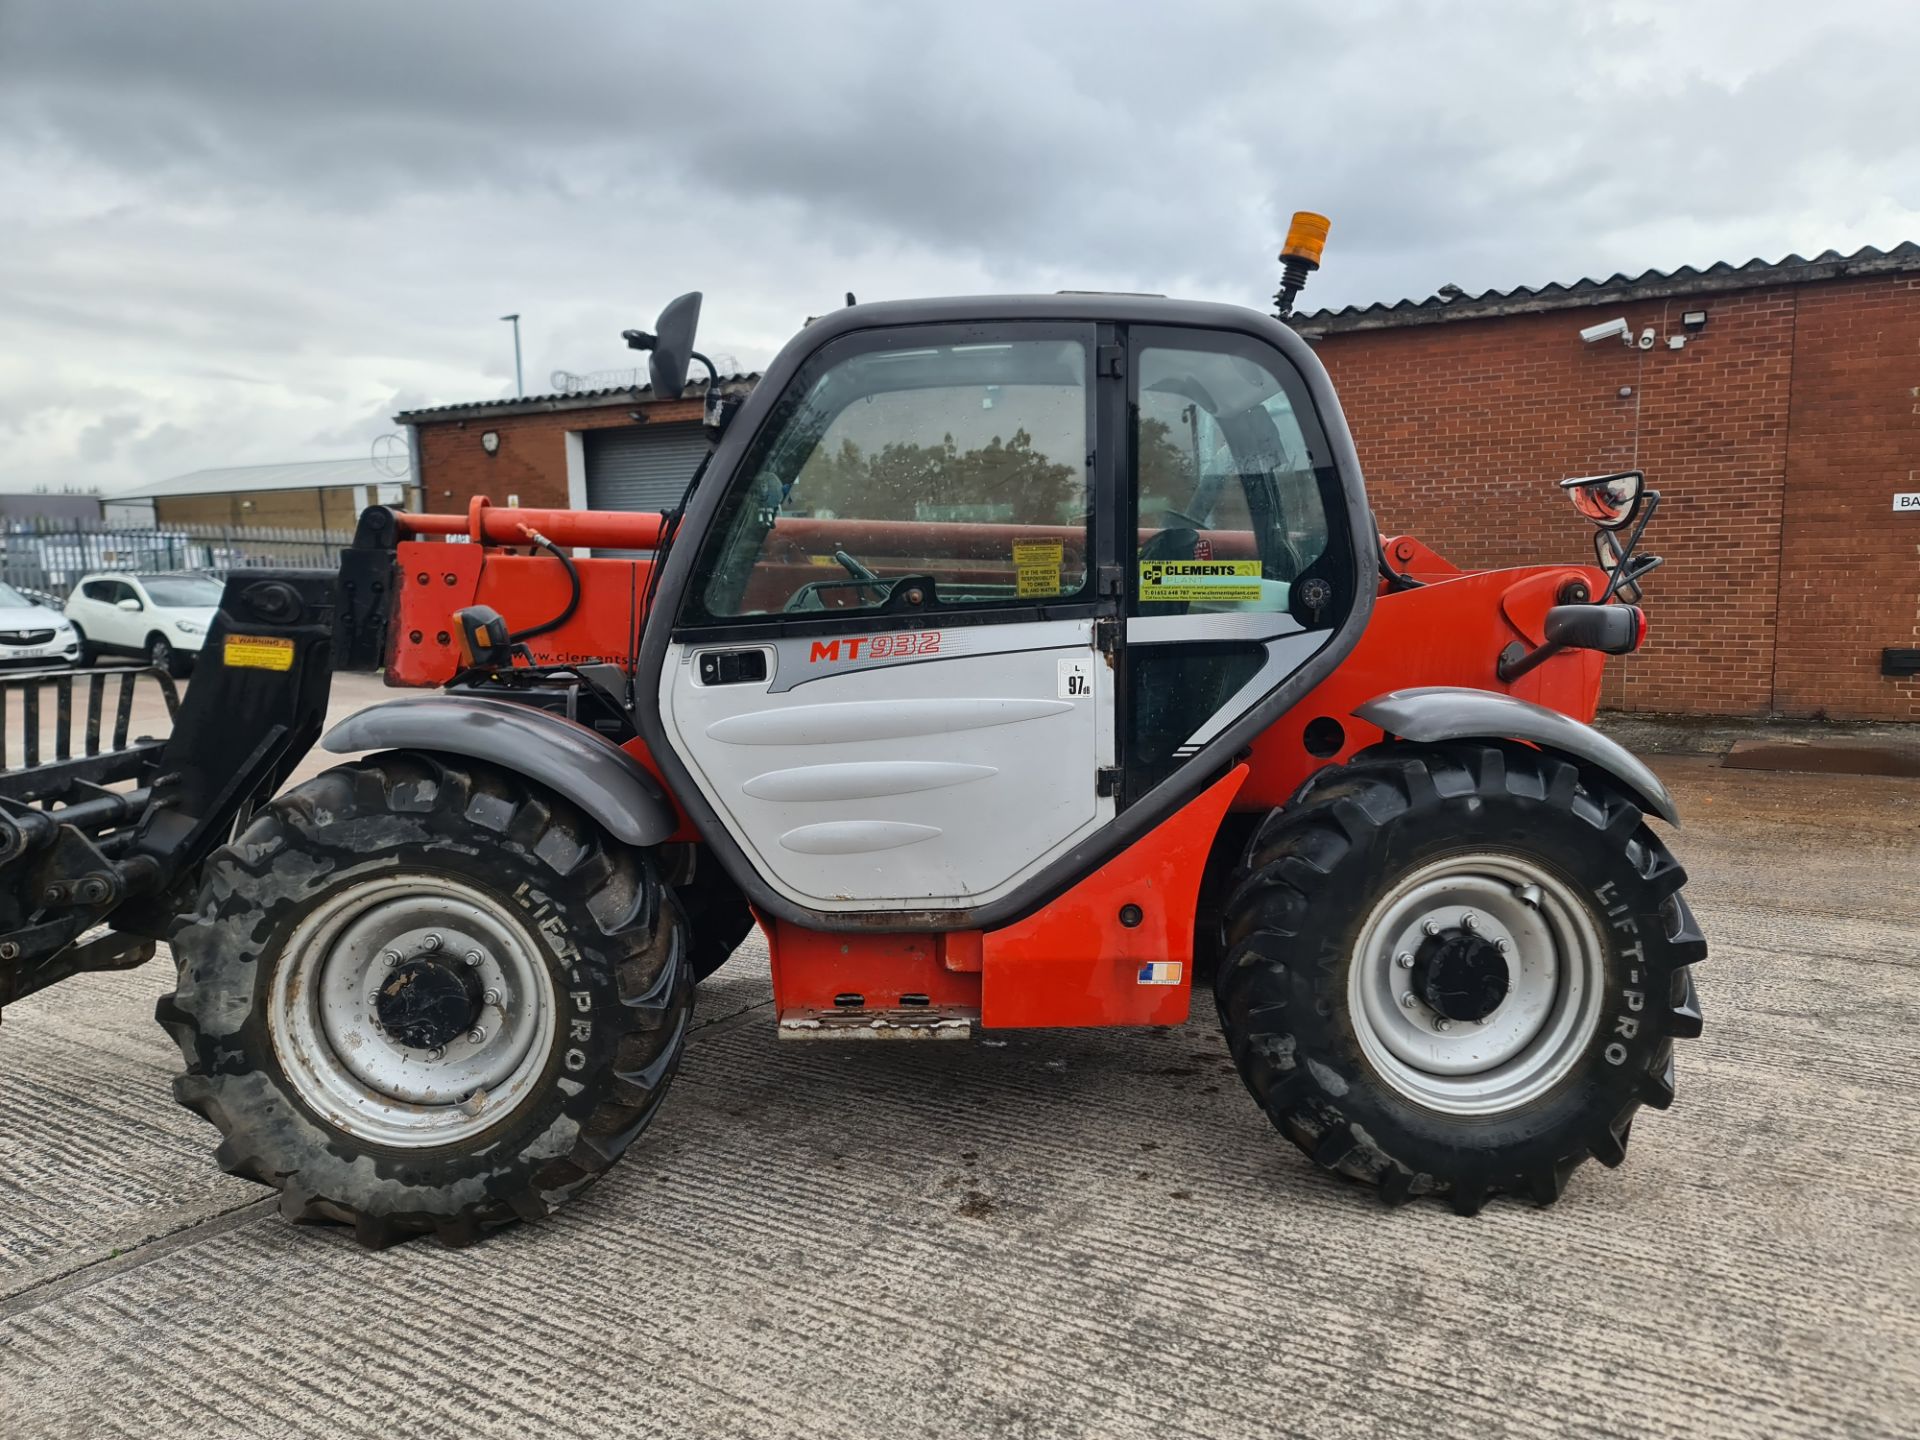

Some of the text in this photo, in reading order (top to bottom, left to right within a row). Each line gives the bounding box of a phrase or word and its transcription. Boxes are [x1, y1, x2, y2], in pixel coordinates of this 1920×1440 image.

[1165, 565, 1235, 576] CLEMENTS
[1166, 576, 1204, 584] PLANT
[1074, 664, 1081, 672] L
[511, 881, 593, 1073] LIFT-PRO
[1593, 880, 1646, 1067] LIFT-PRO
